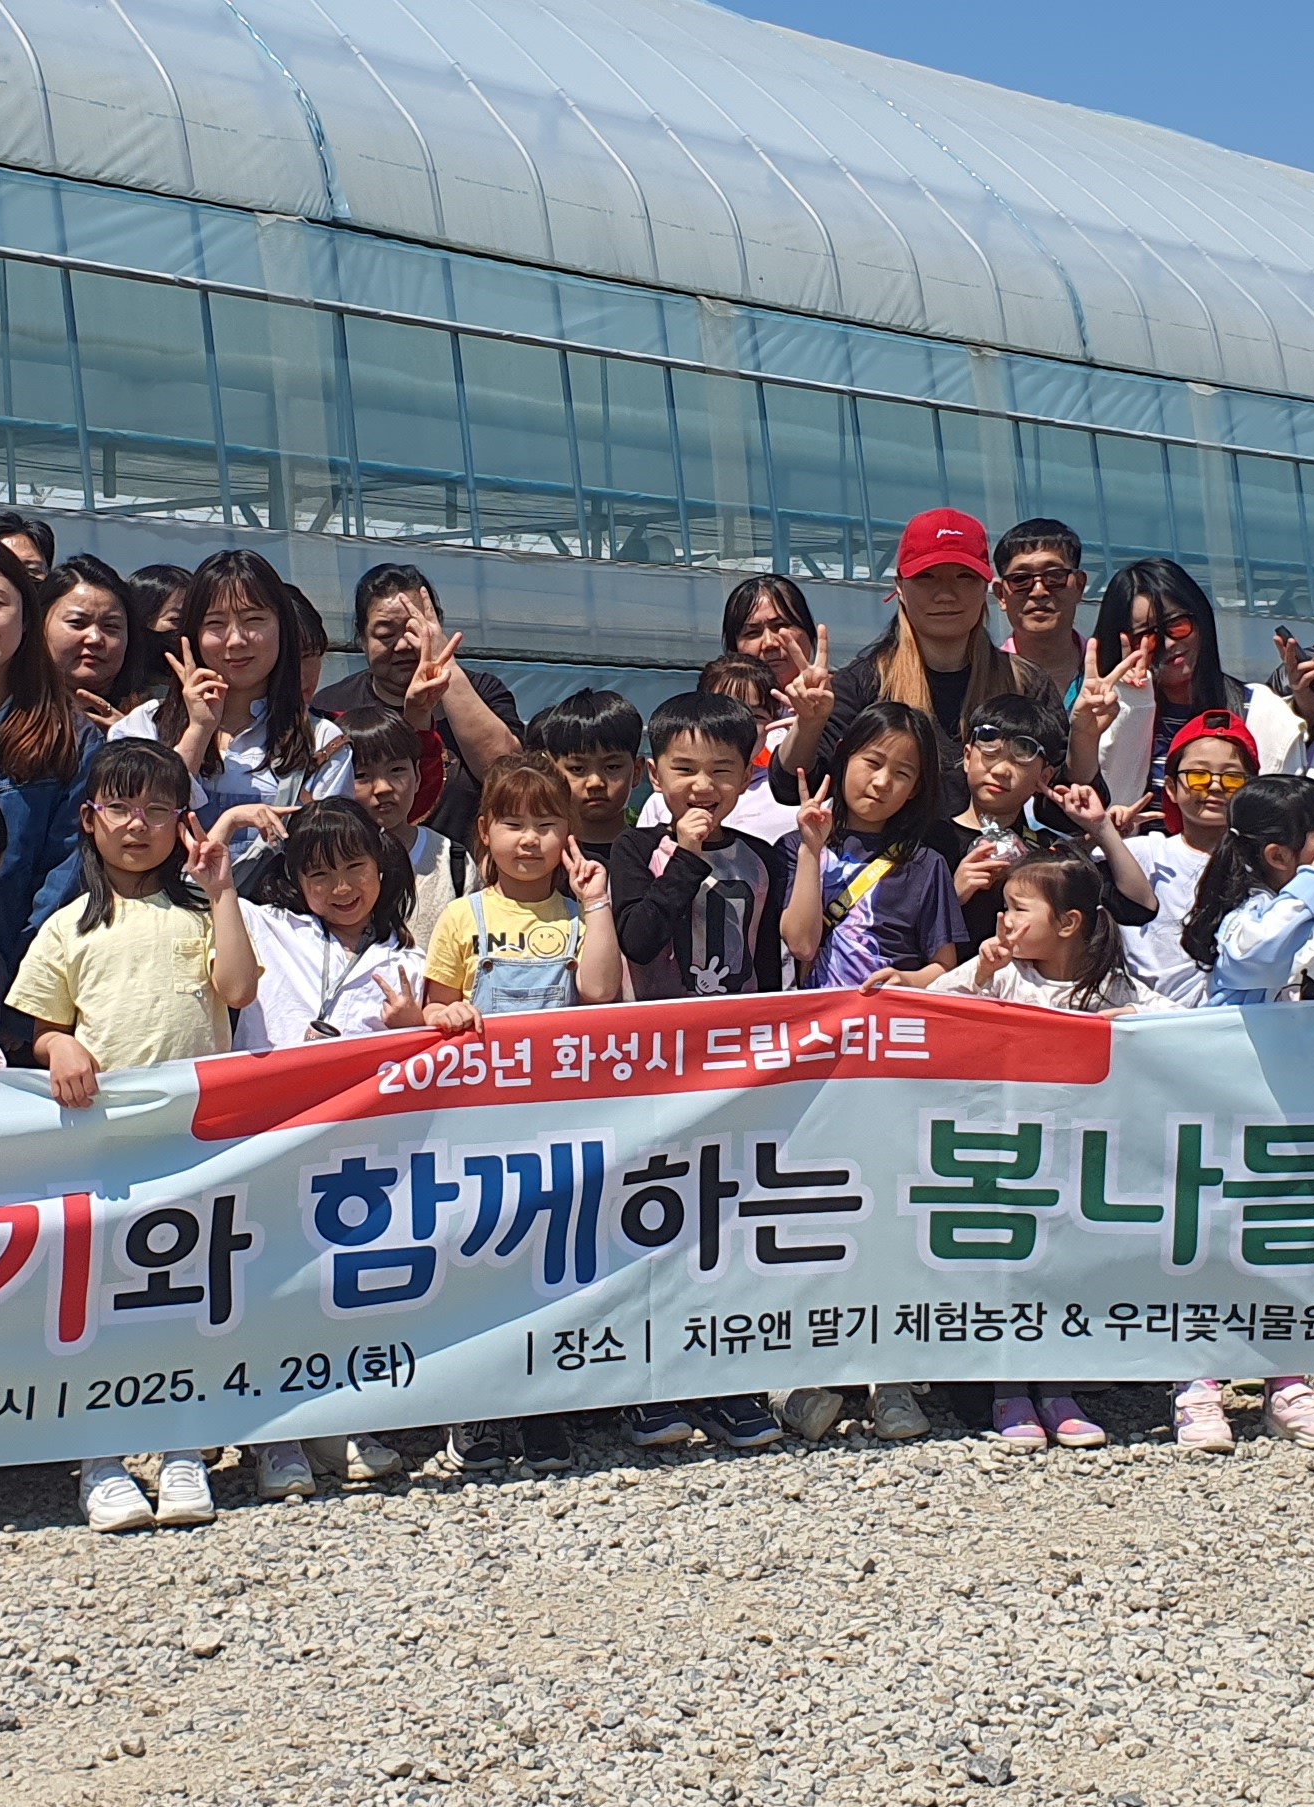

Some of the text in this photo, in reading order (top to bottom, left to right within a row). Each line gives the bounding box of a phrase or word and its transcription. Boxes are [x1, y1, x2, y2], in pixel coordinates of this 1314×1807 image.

[378, 1013, 930, 1094] 2025년 화성시 드림스타트
[311, 1140, 863, 1310] 함께하는
[551, 1327, 627, 1371] 장소
[684, 1309, 792, 1357] 치유앤
[808, 1303, 878, 1345] 딸기
[894, 1302, 1048, 1343] 체험농장
[1061, 1308, 1093, 1338] &
[86, 1368, 206, 1410] 2025.
[223, 1361, 262, 1398] 4.
[279, 1342, 416, 1394] 29.(화)
